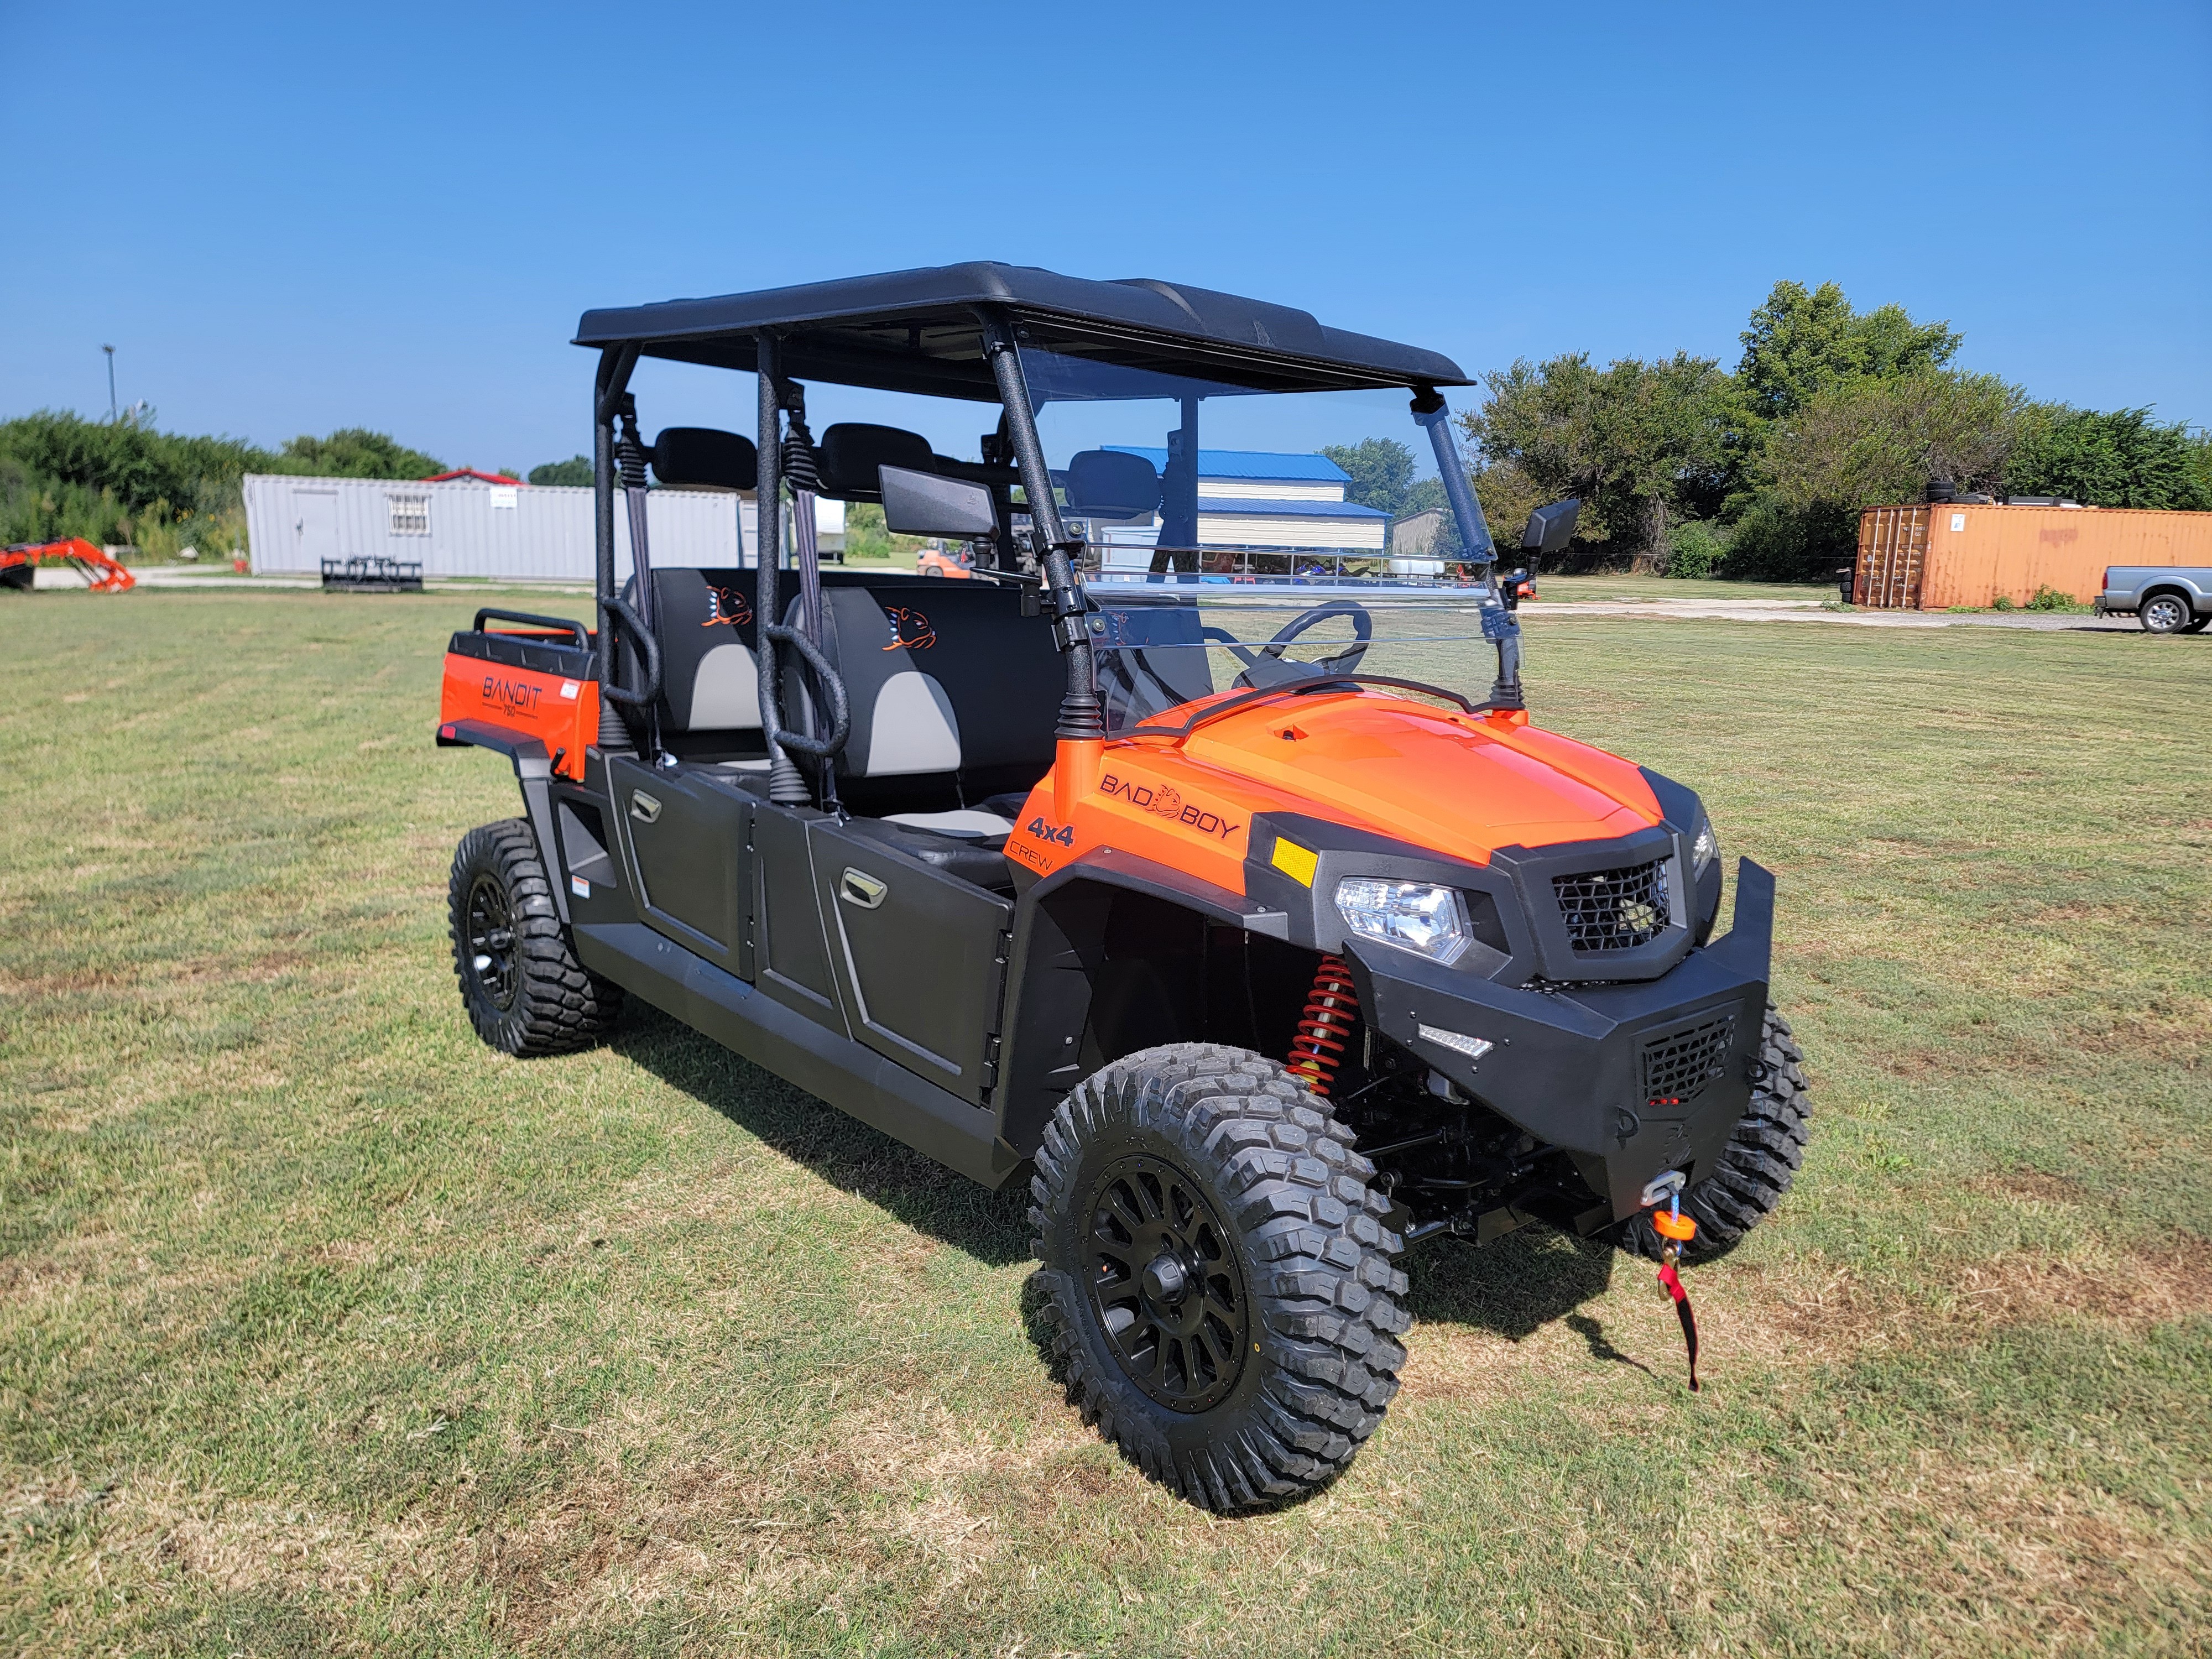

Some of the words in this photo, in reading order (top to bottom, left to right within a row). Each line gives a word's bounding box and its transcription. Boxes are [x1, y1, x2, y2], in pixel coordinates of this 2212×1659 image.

[483, 676, 542, 711] BANDIT
[1099, 774, 1153, 806] BAD
[1179, 804, 1240, 839] BOY
[1027, 817, 1074, 847] 4x4
[1010, 841, 1053, 870] CREW
